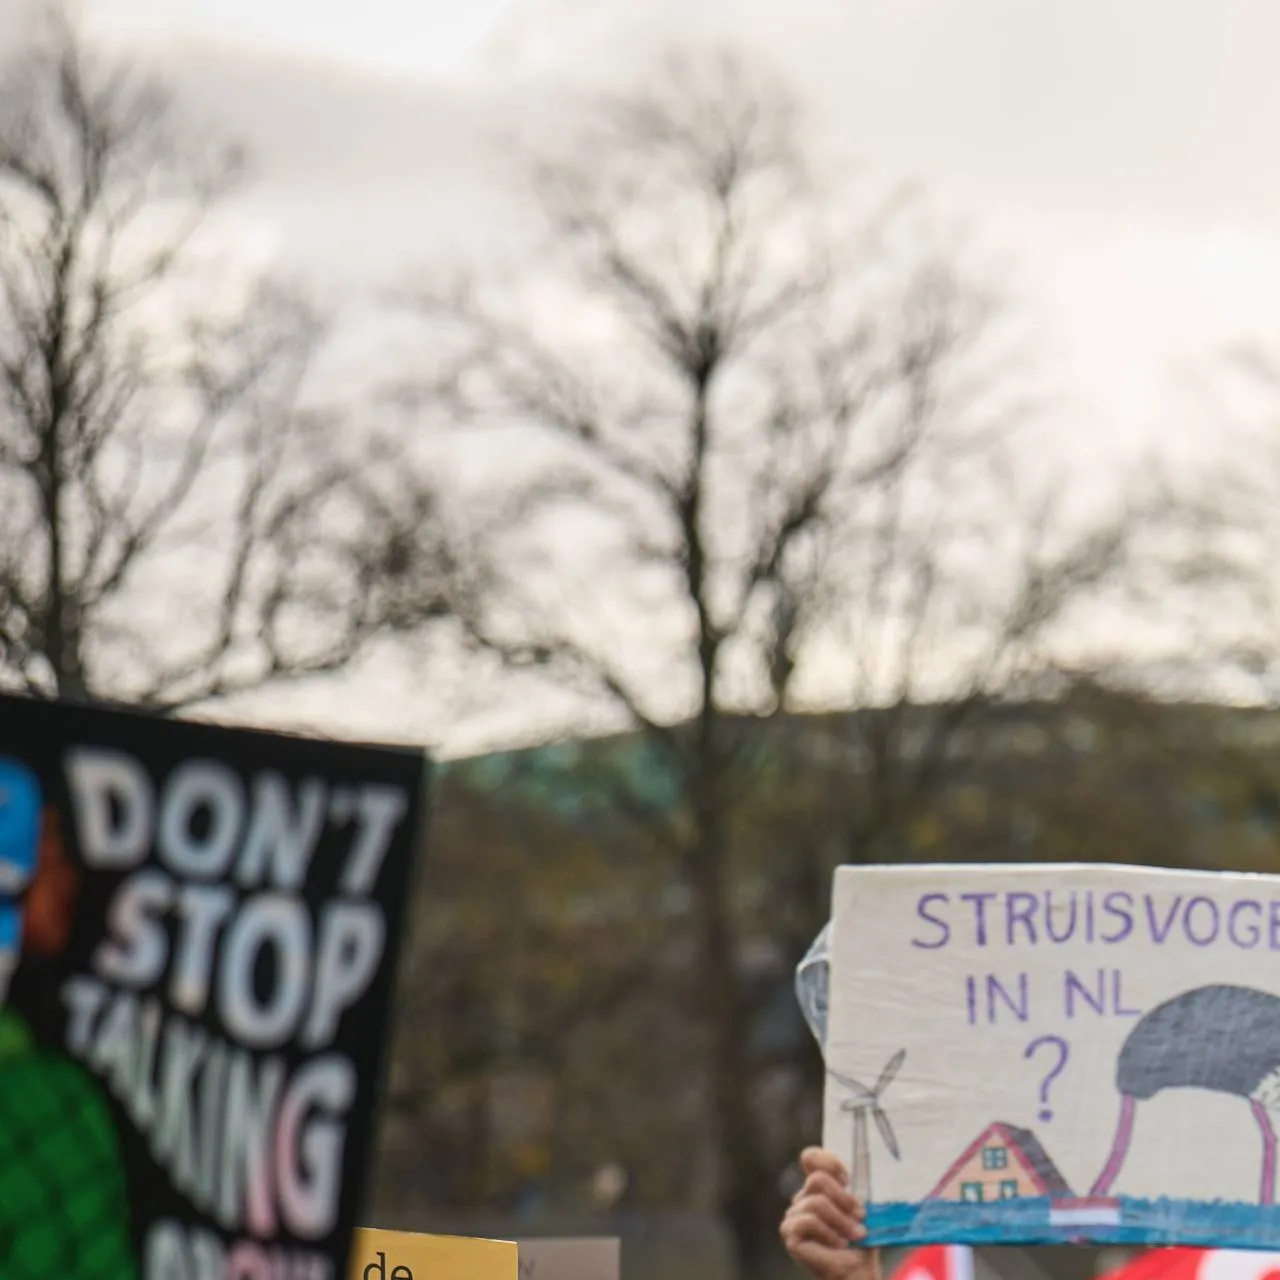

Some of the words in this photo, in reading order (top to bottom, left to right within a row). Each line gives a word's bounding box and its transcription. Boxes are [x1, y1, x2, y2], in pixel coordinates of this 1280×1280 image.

[63, 748, 408, 895] DON'T
[97, 869, 387, 1047] STOP
[967, 974, 1029, 1025] IN
[1064, 969, 1143, 1018] NL
[61, 974, 358, 1240] TALKING
[1023, 1034, 1071, 1123] ?
